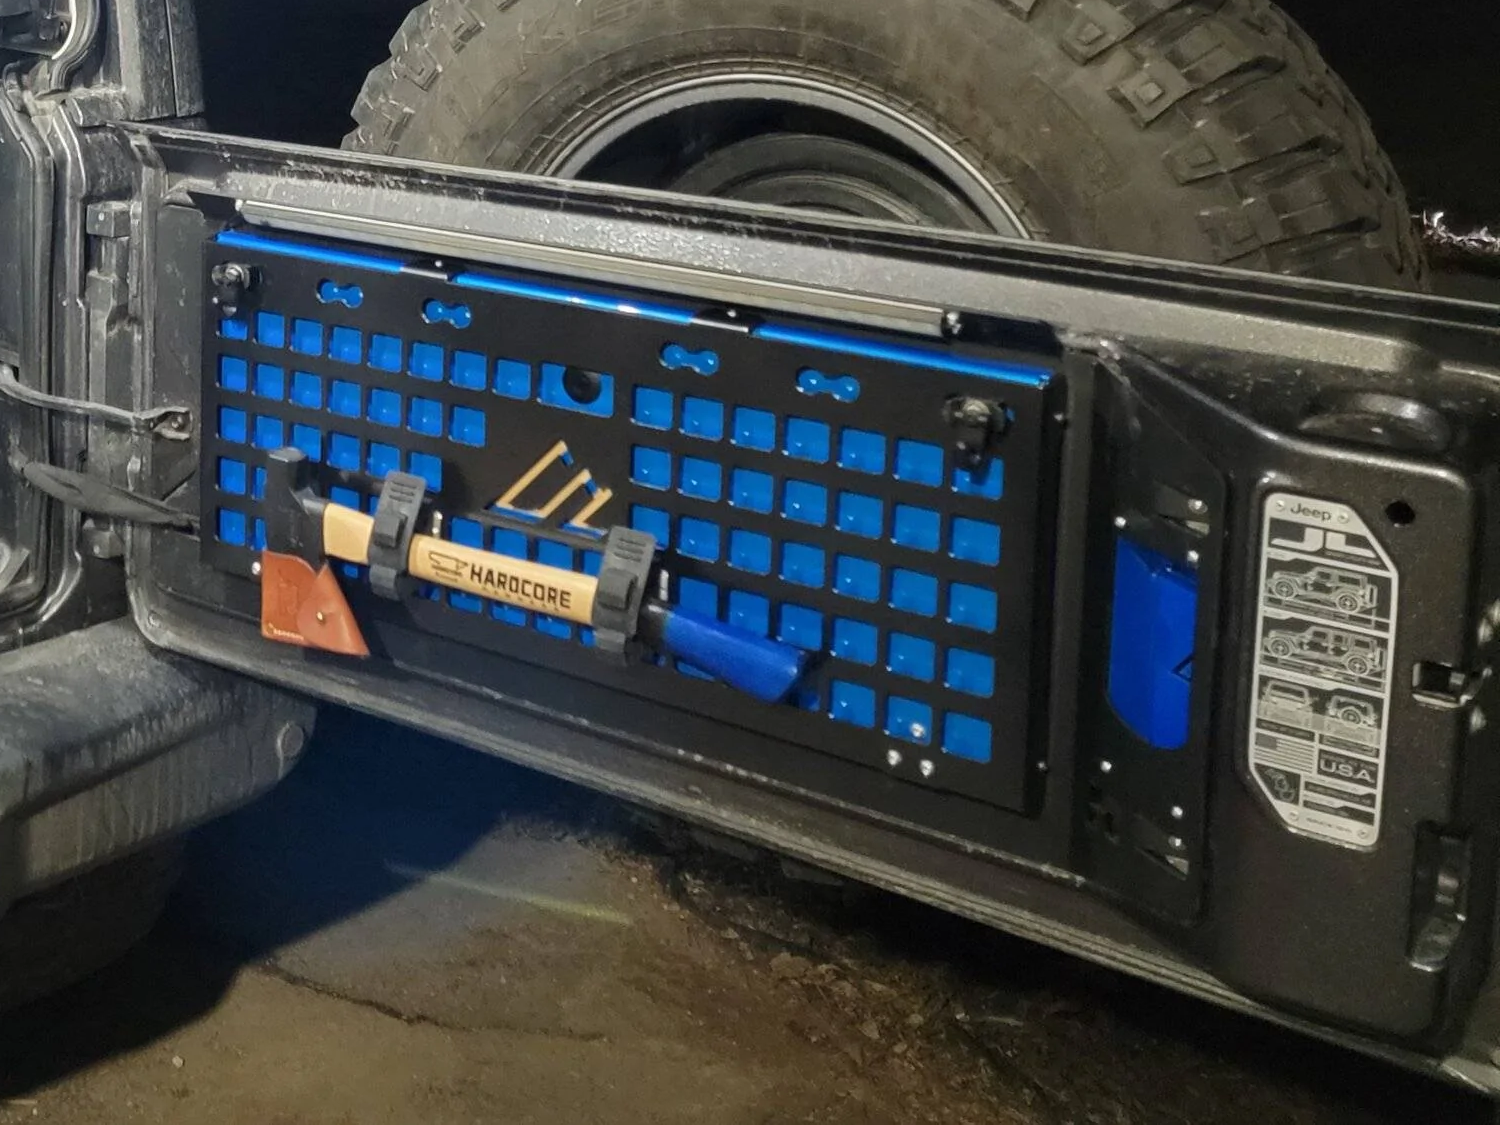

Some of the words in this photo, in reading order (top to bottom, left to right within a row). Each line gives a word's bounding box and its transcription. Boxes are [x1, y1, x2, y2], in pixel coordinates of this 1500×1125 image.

[1290, 503, 1332, 522] Jeep
[1271, 527, 1377, 558] JL
[470, 562, 572, 610] HARDCORE
